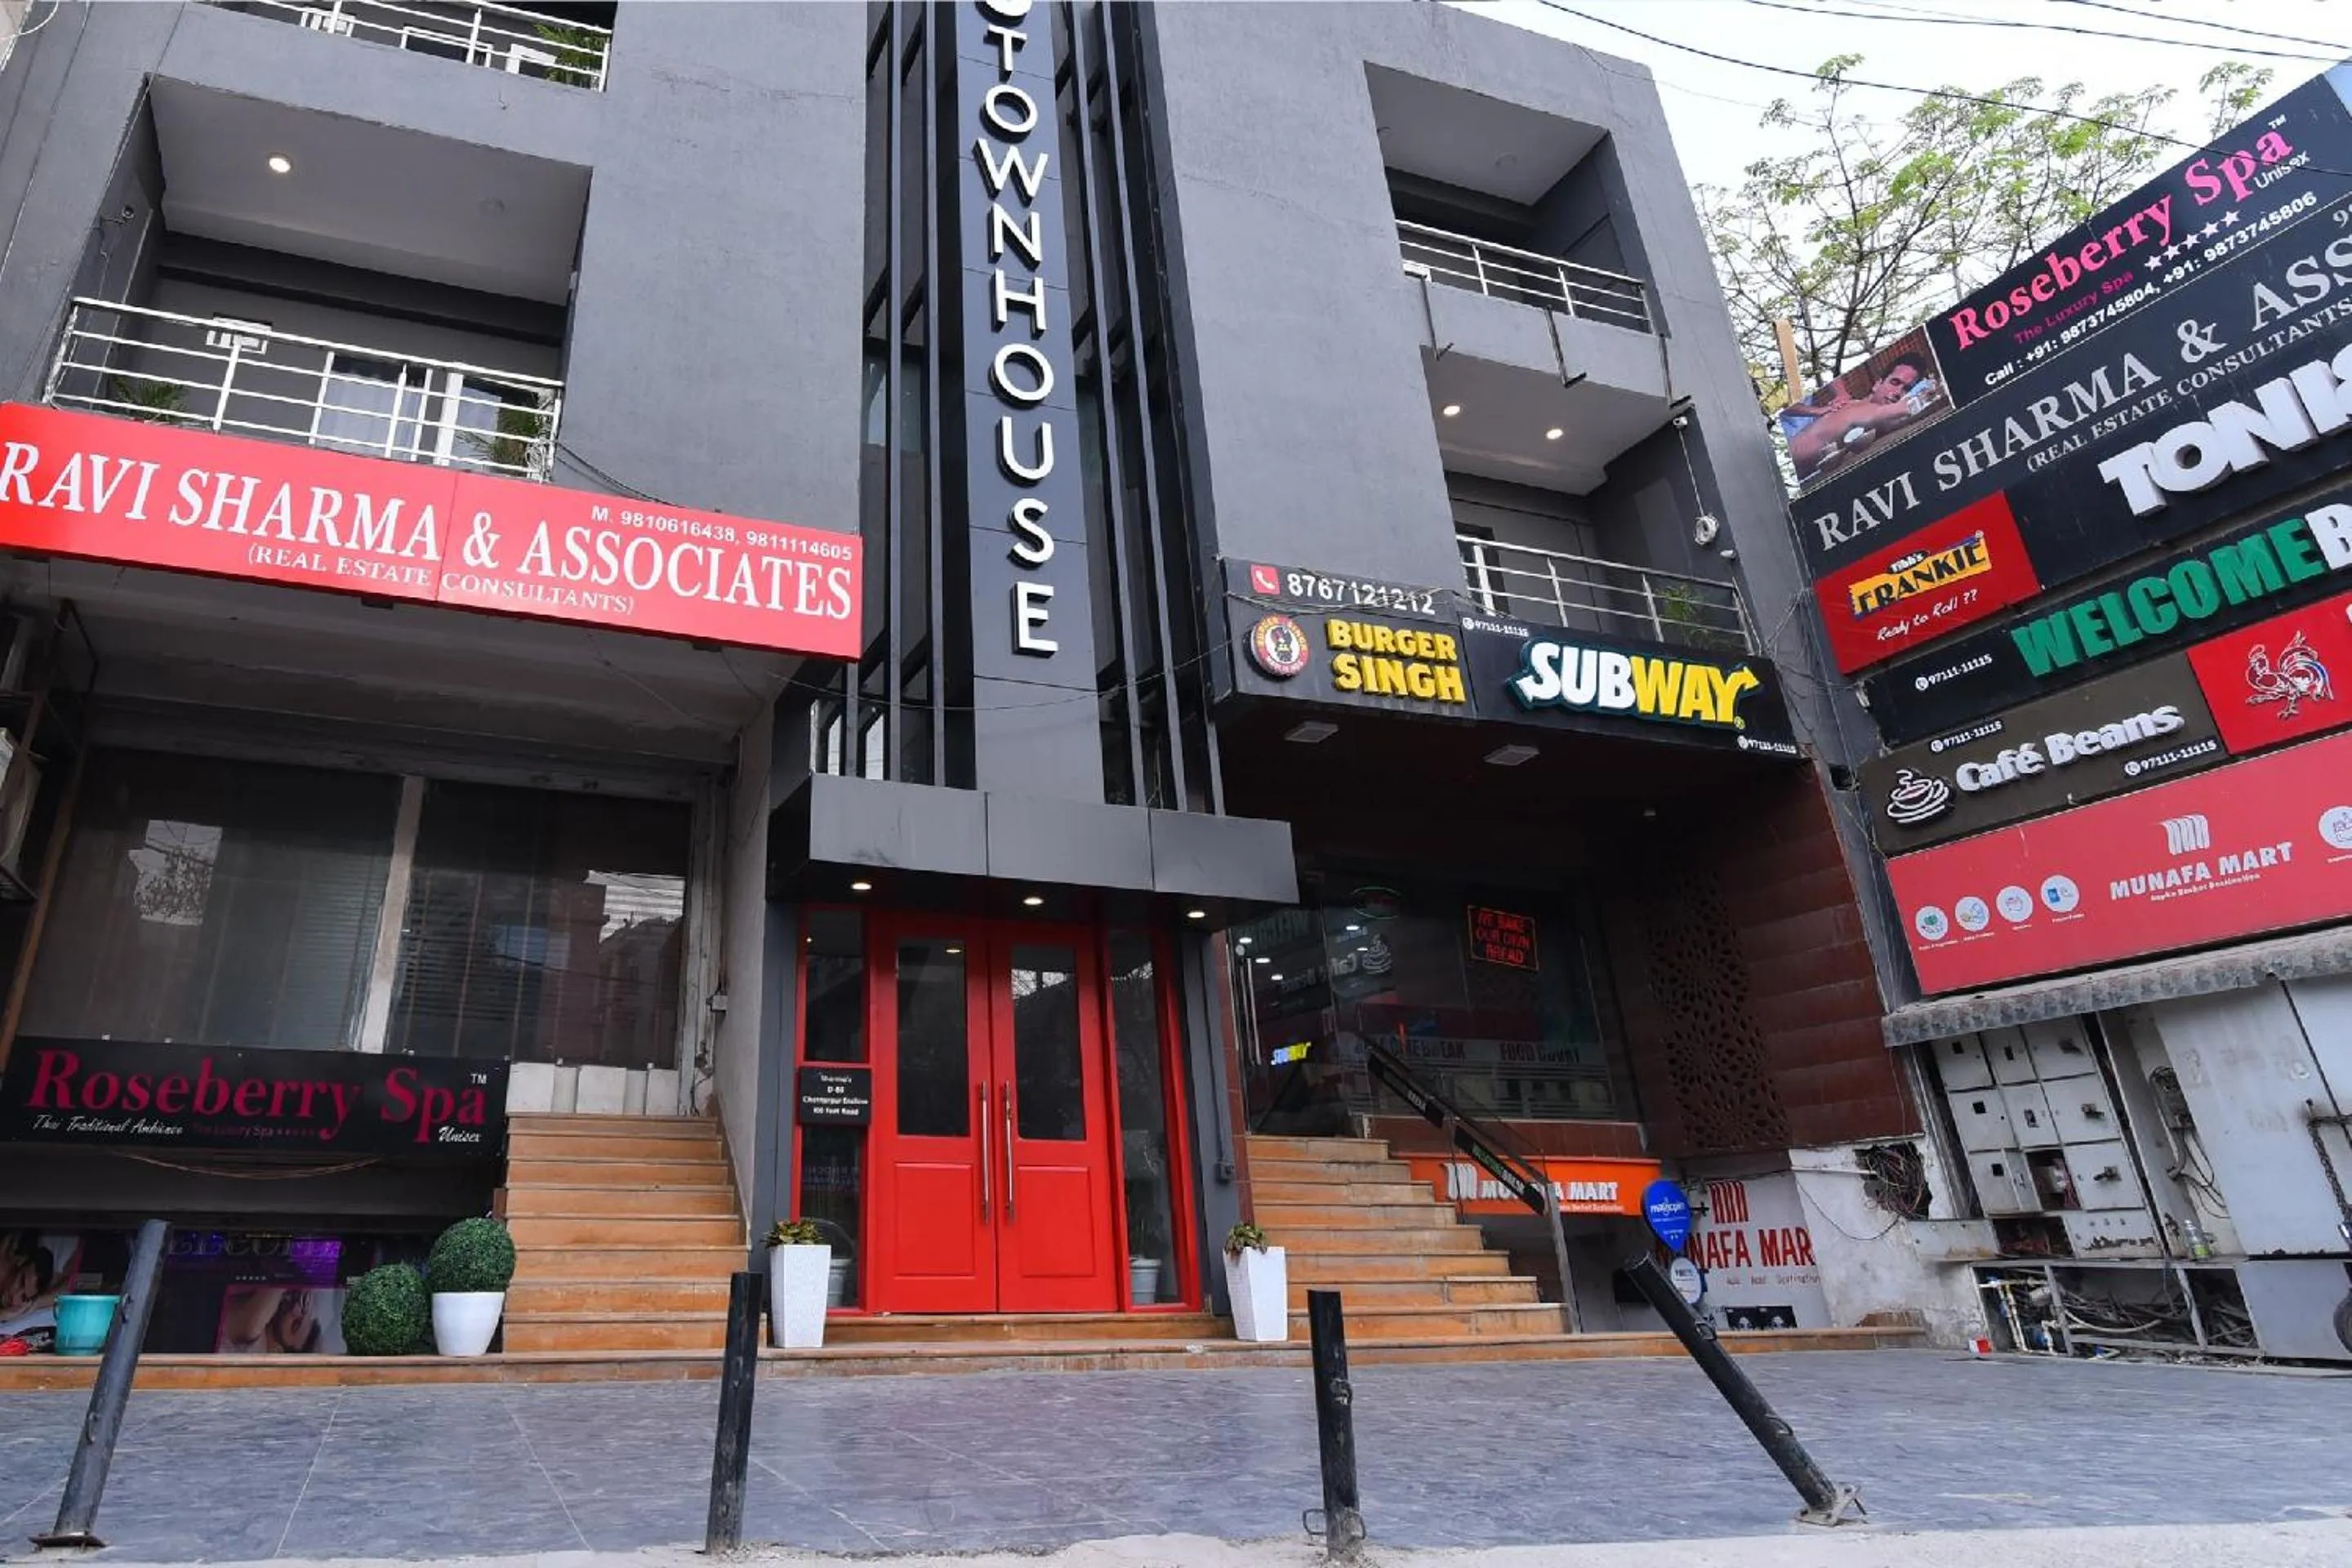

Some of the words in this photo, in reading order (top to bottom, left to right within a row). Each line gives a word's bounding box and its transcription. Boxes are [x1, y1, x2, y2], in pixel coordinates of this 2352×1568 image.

[2254, 150, 2311, 190] Unisex
[1948, 190, 2174, 352] Roseberry
[2184, 127, 2295, 207] Spa
[1984, 362, 2015, 386] Call
[2203, 190, 2318, 262] 9873745806
[2014, 325, 2043, 344] The
[2045, 292, 2098, 327] Luxury
[2100, 271, 2134, 295] Spa
[977, 24, 1058, 653] TOWNHOUSE
[1814, 470, 1922, 553] RAVI
[1931, 351, 2163, 492] SHARMA
[2176, 318, 2229, 363] &
[2026, 430, 2089, 471] (REAL
[2091, 388, 2173, 440] ESTATE
[0, 441, 160, 521] RAVI
[168, 467, 441, 562] SHARMA
[462, 511, 501, 570] &
[516, 519, 853, 621] ASSOCIATES
[745, 531, 853, 562] 9811114605
[248, 541, 327, 573] (REAL
[336, 557, 433, 589] ESTATE
[441, 572, 636, 616] CONSULTANTS)
[1286, 572, 1437, 616] 8767121212
[1857, 543, 1986, 613] FRANKIE
[1326, 618, 1459, 663] BURGER
[1877, 621, 1910, 641] Ready
[1913, 614, 1929, 626] to
[1931, 595, 1958, 617] Roll
[1332, 653, 1467, 703] SINGH
[1516, 641, 1761, 724] SUBWAY
[1928, 653, 1993, 685] 97111-11115
[1943, 720, 2002, 746] 97111-11115
[1955, 741, 2046, 793] Café
[2045, 704, 2185, 768] Beans
[2140, 740, 2217, 770] 97111-11115
[2109, 862, 2212, 901] MUNAFA
[2218, 841, 2293, 876] MART
[24, 1048, 364, 1141] Roseberry
[381, 1067, 488, 1143] Spa
[438, 1125, 482, 1143] Unisex
[1567, 1181, 1619, 1201] MART
